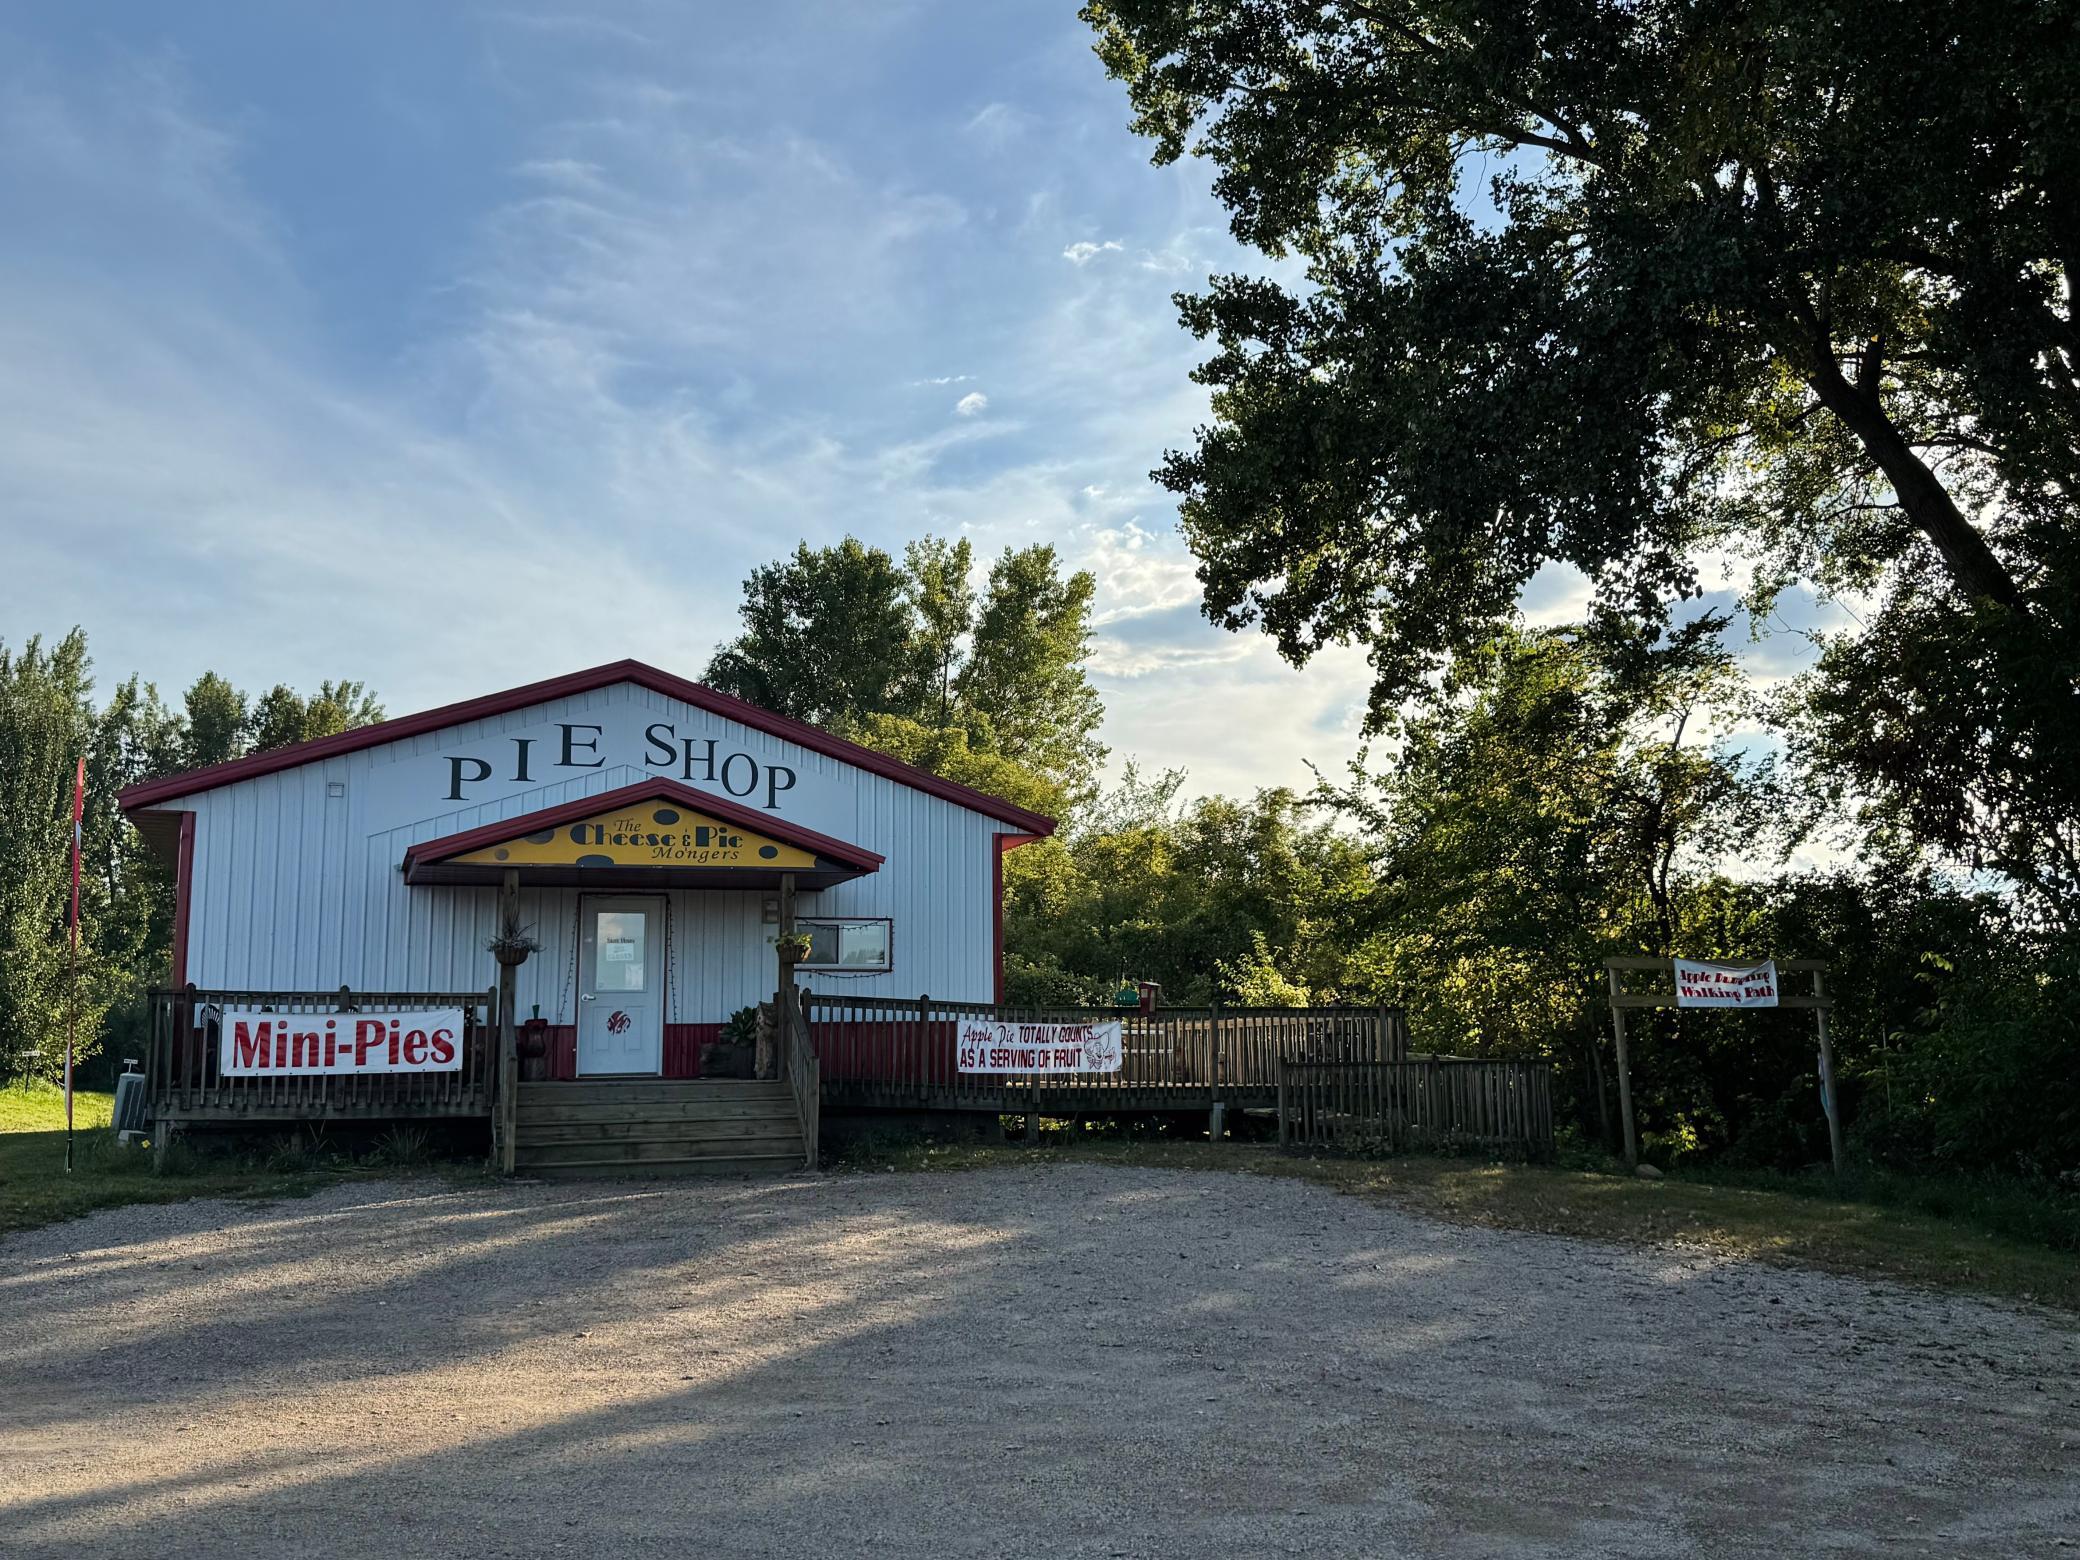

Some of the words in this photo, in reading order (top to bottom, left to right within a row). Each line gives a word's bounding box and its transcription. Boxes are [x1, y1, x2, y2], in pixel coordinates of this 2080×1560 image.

[442, 723, 606, 801] PIE
[645, 723, 797, 810] SHOP
[614, 818, 641, 832] The
[570, 823, 676, 846] Cheese
[695, 826, 743, 848] Pie
[652, 846, 739, 863] Mongers
[1680, 970, 1711, 983] Apple
[1680, 986, 1742, 1003] Walking
[1744, 986, 1775, 997] Path
[233, 1019, 455, 1069] Mini-Pies
[961, 1023, 993, 1049] Apple
[997, 1024, 1014, 1048] Pie
[1019, 1025, 1058, 1044] TOTALLY
[960, 1048, 975, 1068] AS
[978, 1048, 986, 1068] A
[990, 1048, 1035, 1068] SERVING
[1038, 1049, 1051, 1068] OF
[1053, 1048, 1083, 1068] FRUIT
